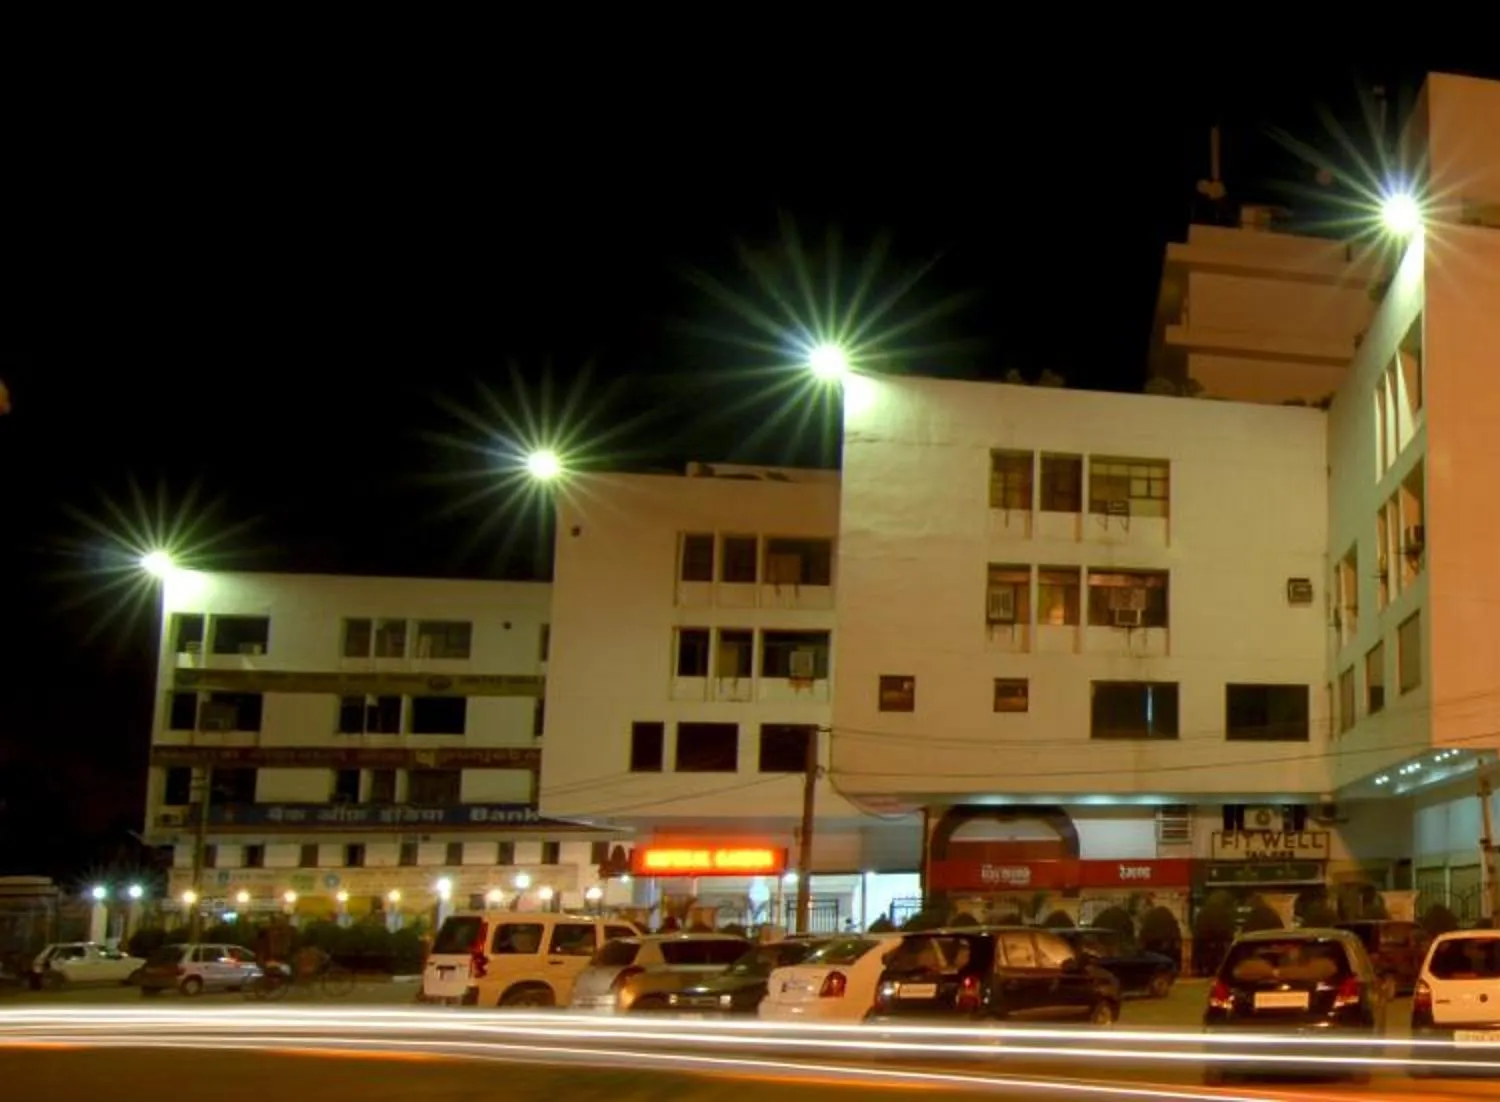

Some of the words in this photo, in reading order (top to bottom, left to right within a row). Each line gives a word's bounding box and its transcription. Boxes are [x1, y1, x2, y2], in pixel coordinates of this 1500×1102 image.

[469, 806, 540, 822] Bank
[1221, 831, 1254, 849] FIT
[1260, 831, 1325, 850] WELL
